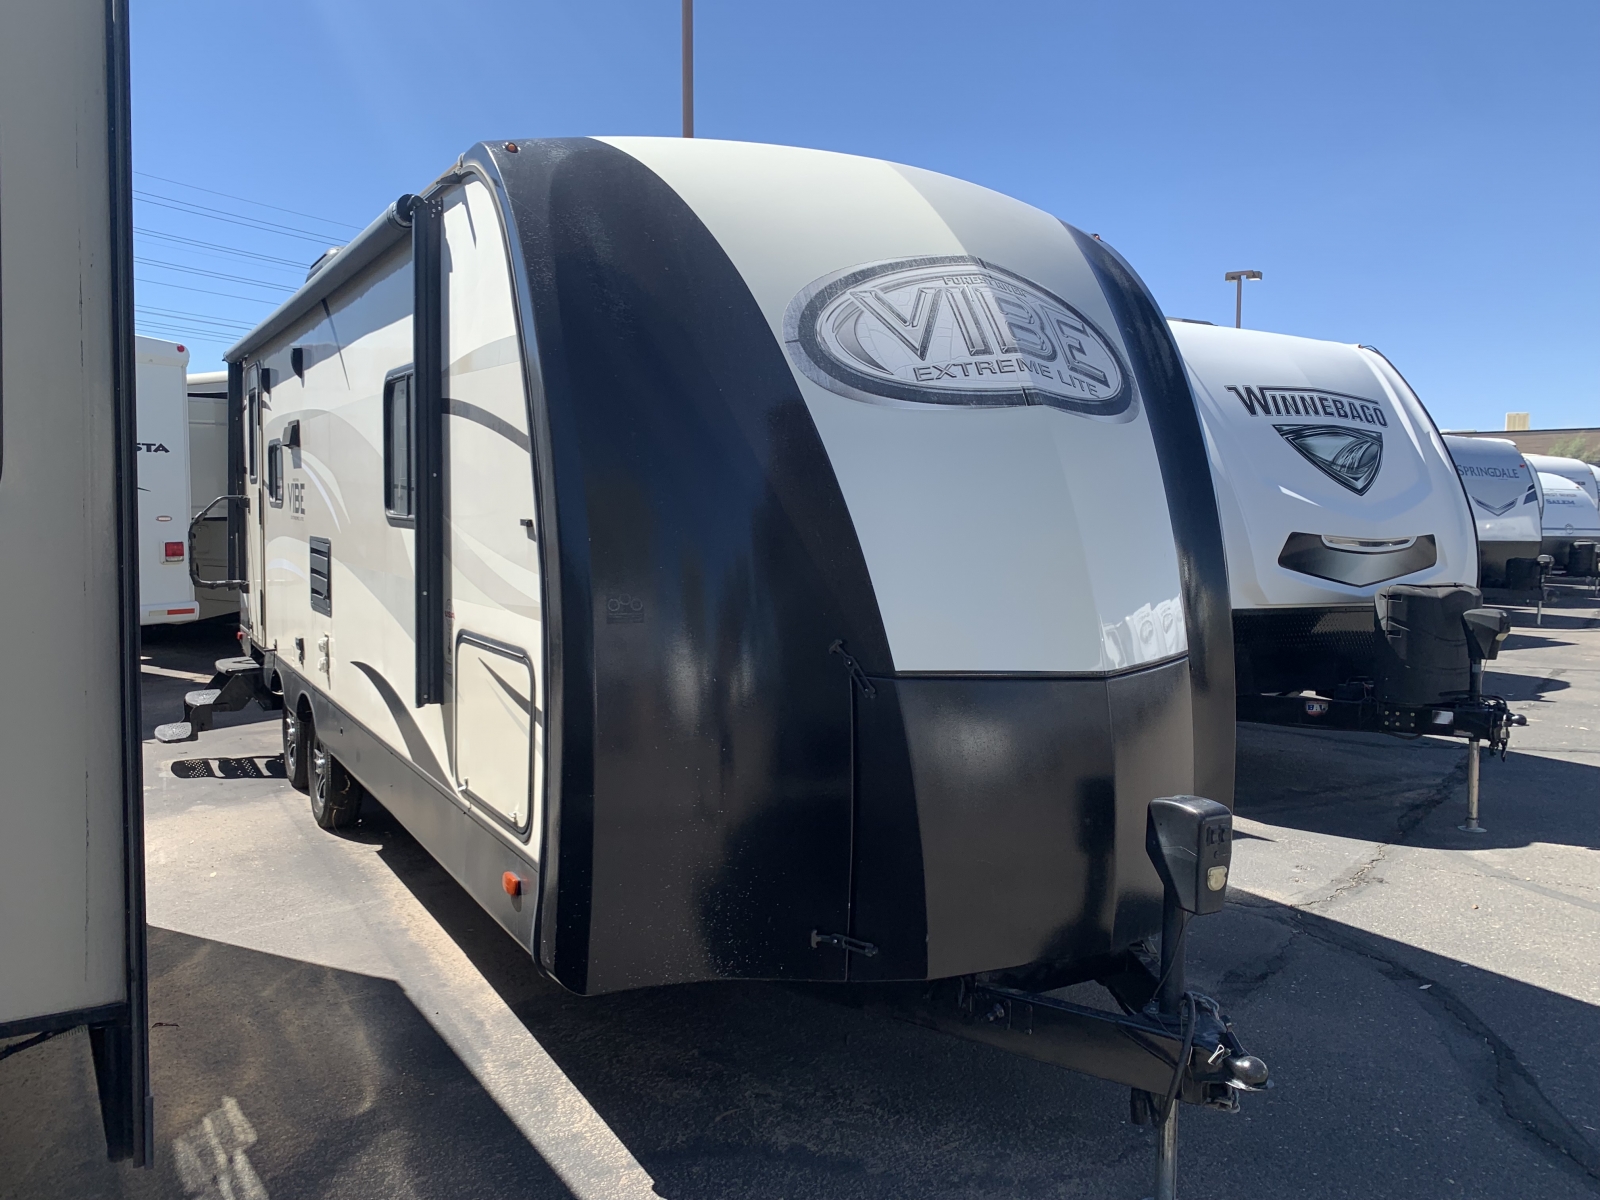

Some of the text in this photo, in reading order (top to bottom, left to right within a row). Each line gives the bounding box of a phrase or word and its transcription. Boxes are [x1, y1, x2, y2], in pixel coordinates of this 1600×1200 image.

[941, 275, 996, 287] FOREST
[850, 286, 1111, 389] VIBE
[913, 358, 1101, 399] EXTREME LITE
[1224, 385, 1388, 428] WINNEBAGO
[1456, 464, 1520, 479] SPRINGDALE
[287, 482, 306, 515] VIBE
